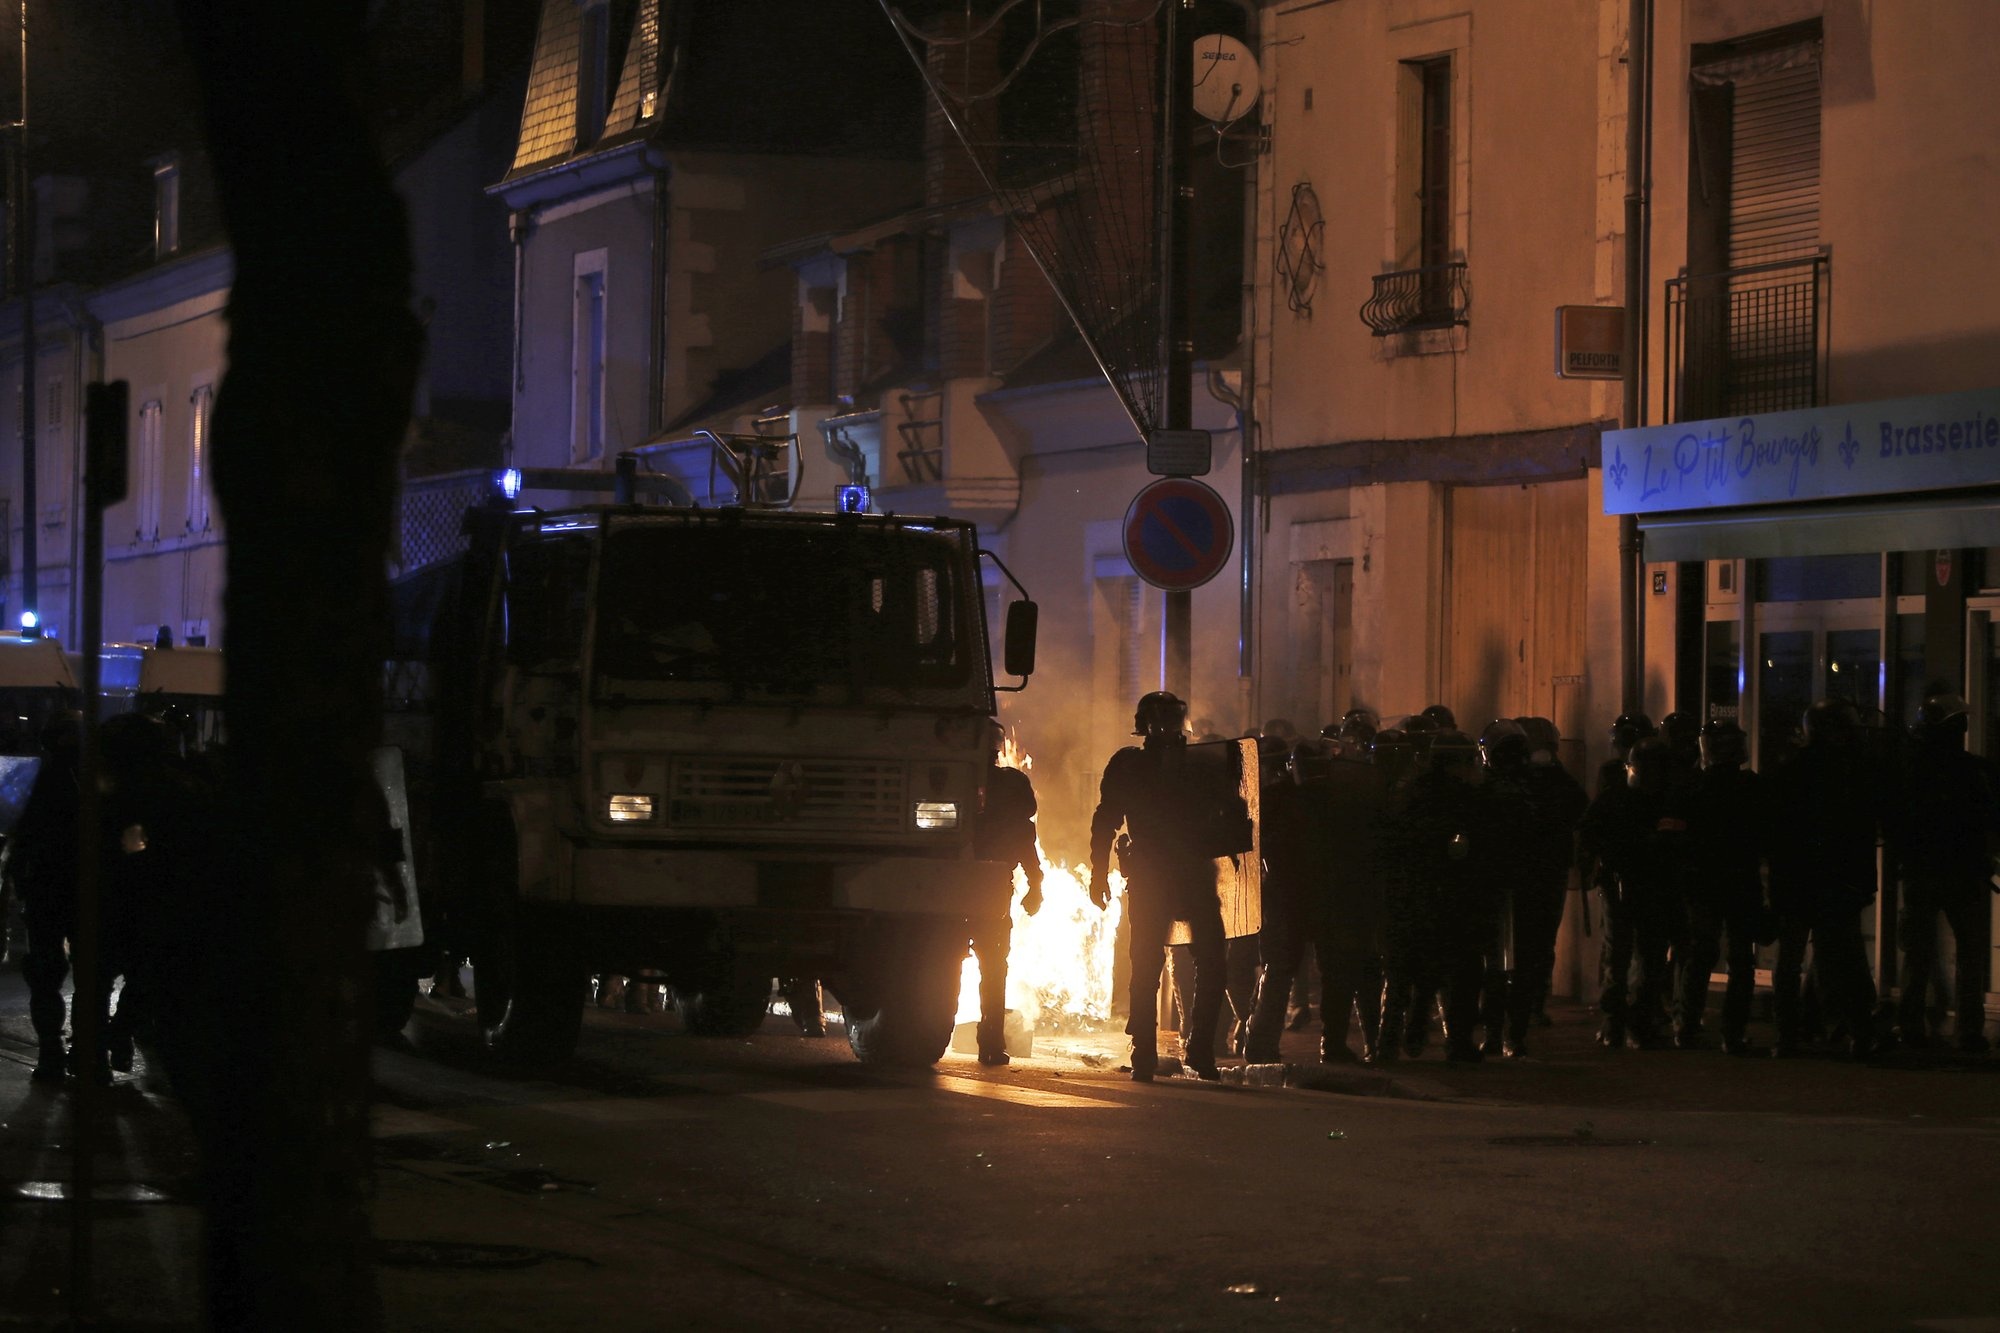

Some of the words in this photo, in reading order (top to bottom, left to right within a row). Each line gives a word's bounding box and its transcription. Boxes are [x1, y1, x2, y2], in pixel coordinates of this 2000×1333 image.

[1569, 352, 1620, 368] PELFORTH
[1640, 444, 1669, 502] Le
[1736, 418, 1821, 497] Bourges
[1879, 411, 2000, 459] Brasserie
